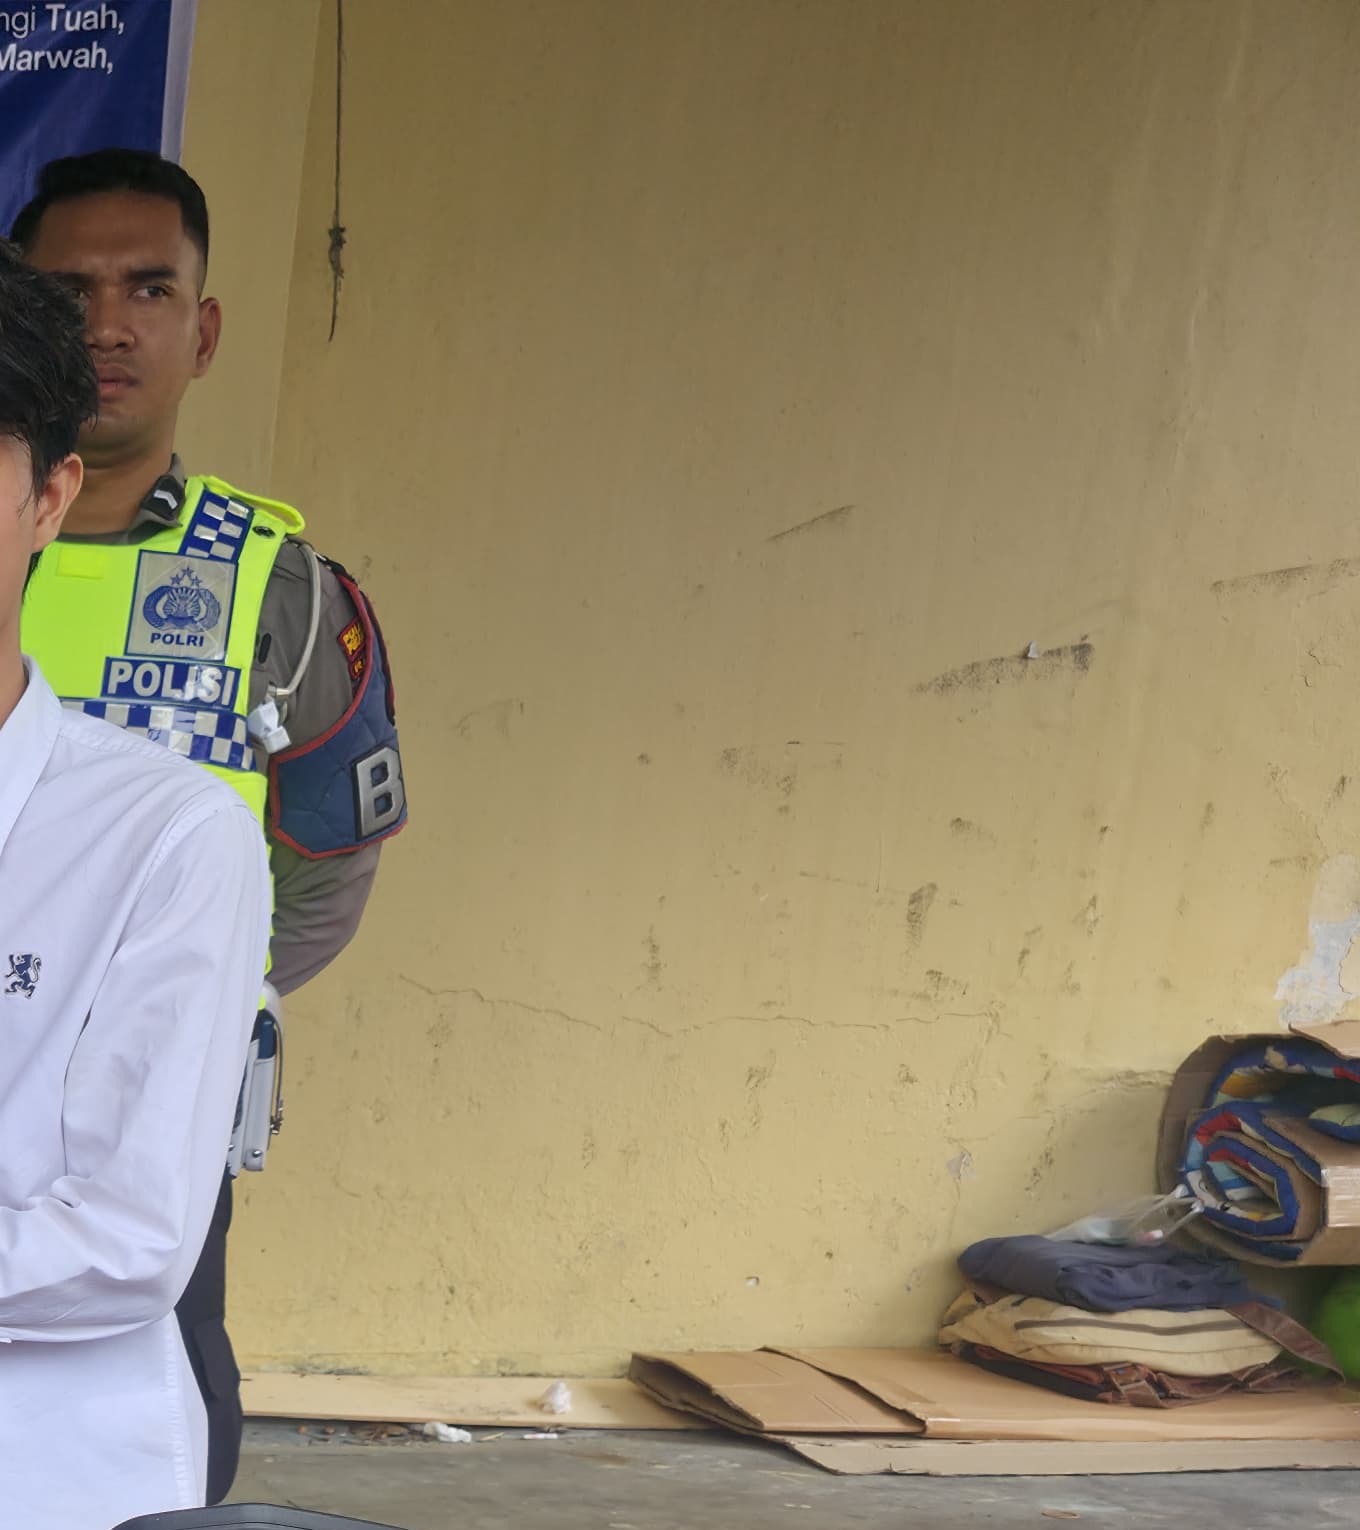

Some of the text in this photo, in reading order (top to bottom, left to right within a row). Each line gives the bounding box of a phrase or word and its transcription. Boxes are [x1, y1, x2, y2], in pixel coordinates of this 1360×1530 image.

[45, 3, 126, 35] Tuah,
[149, 632, 205, 648] POLRI
[107, 660, 236, 706] POLISI
[355, 746, 406, 838] B
